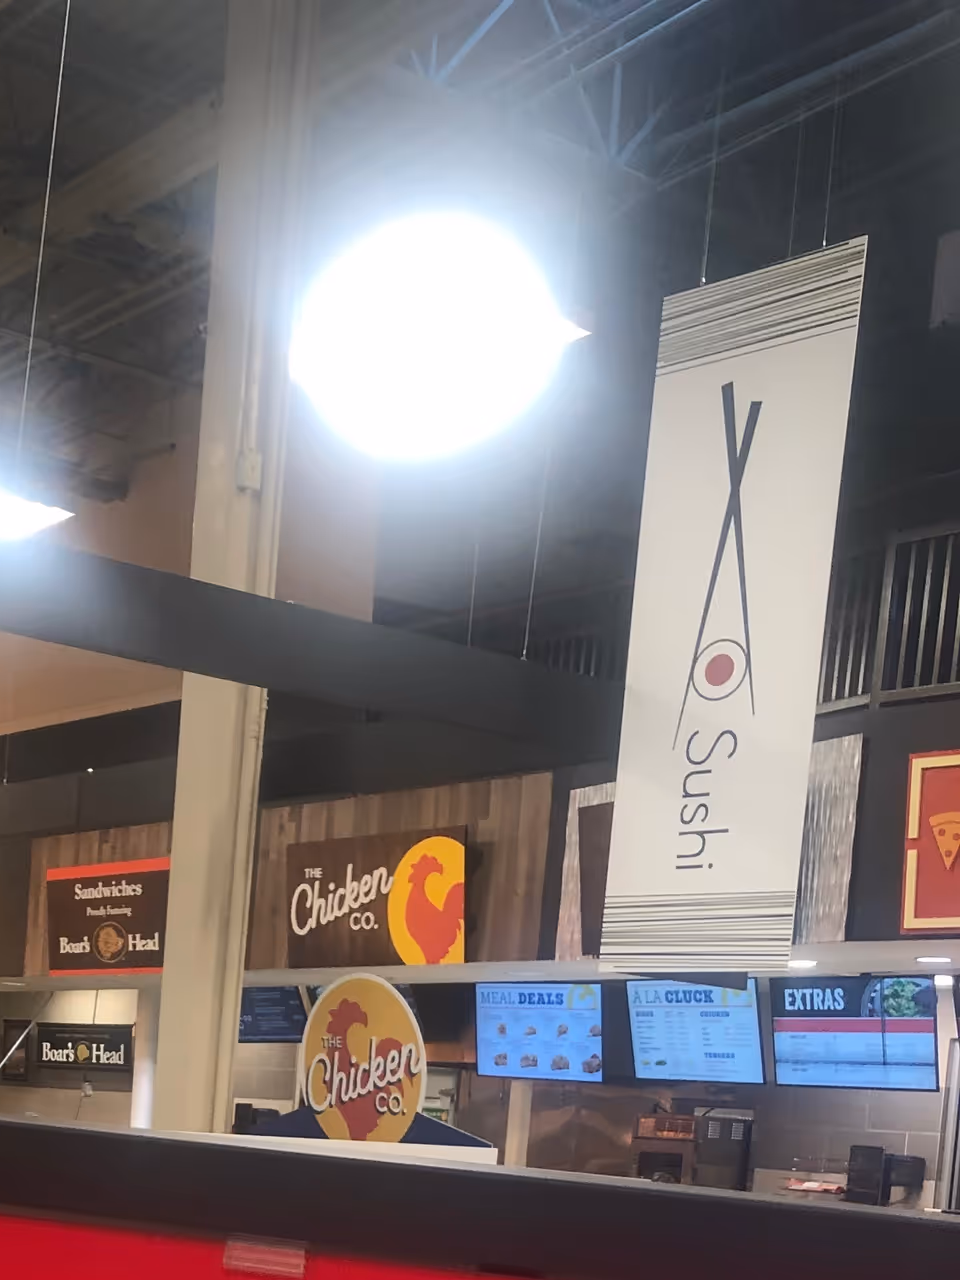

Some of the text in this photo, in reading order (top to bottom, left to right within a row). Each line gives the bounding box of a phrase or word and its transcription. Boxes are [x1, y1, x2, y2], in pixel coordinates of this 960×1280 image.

[675, 728, 739, 872] Sushi
[304, 867, 323, 879] THE
[74, 880, 143, 900] Sandwiches
[290, 863, 394, 936] Chicken
[349, 912, 379, 930] CO.
[59, 932, 159, 954] Boar's Head
[480, 991, 565, 1006] MEAL DEALS
[664, 989, 715, 1004] CLUCK
[784, 987, 845, 1011] EXTRAS
[41, 1042, 125, 1065] Boar's Head
[321, 1036, 343, 1049] THE
[307, 1036, 423, 1113] Chicken
[375, 1092, 408, 1115] CO.
